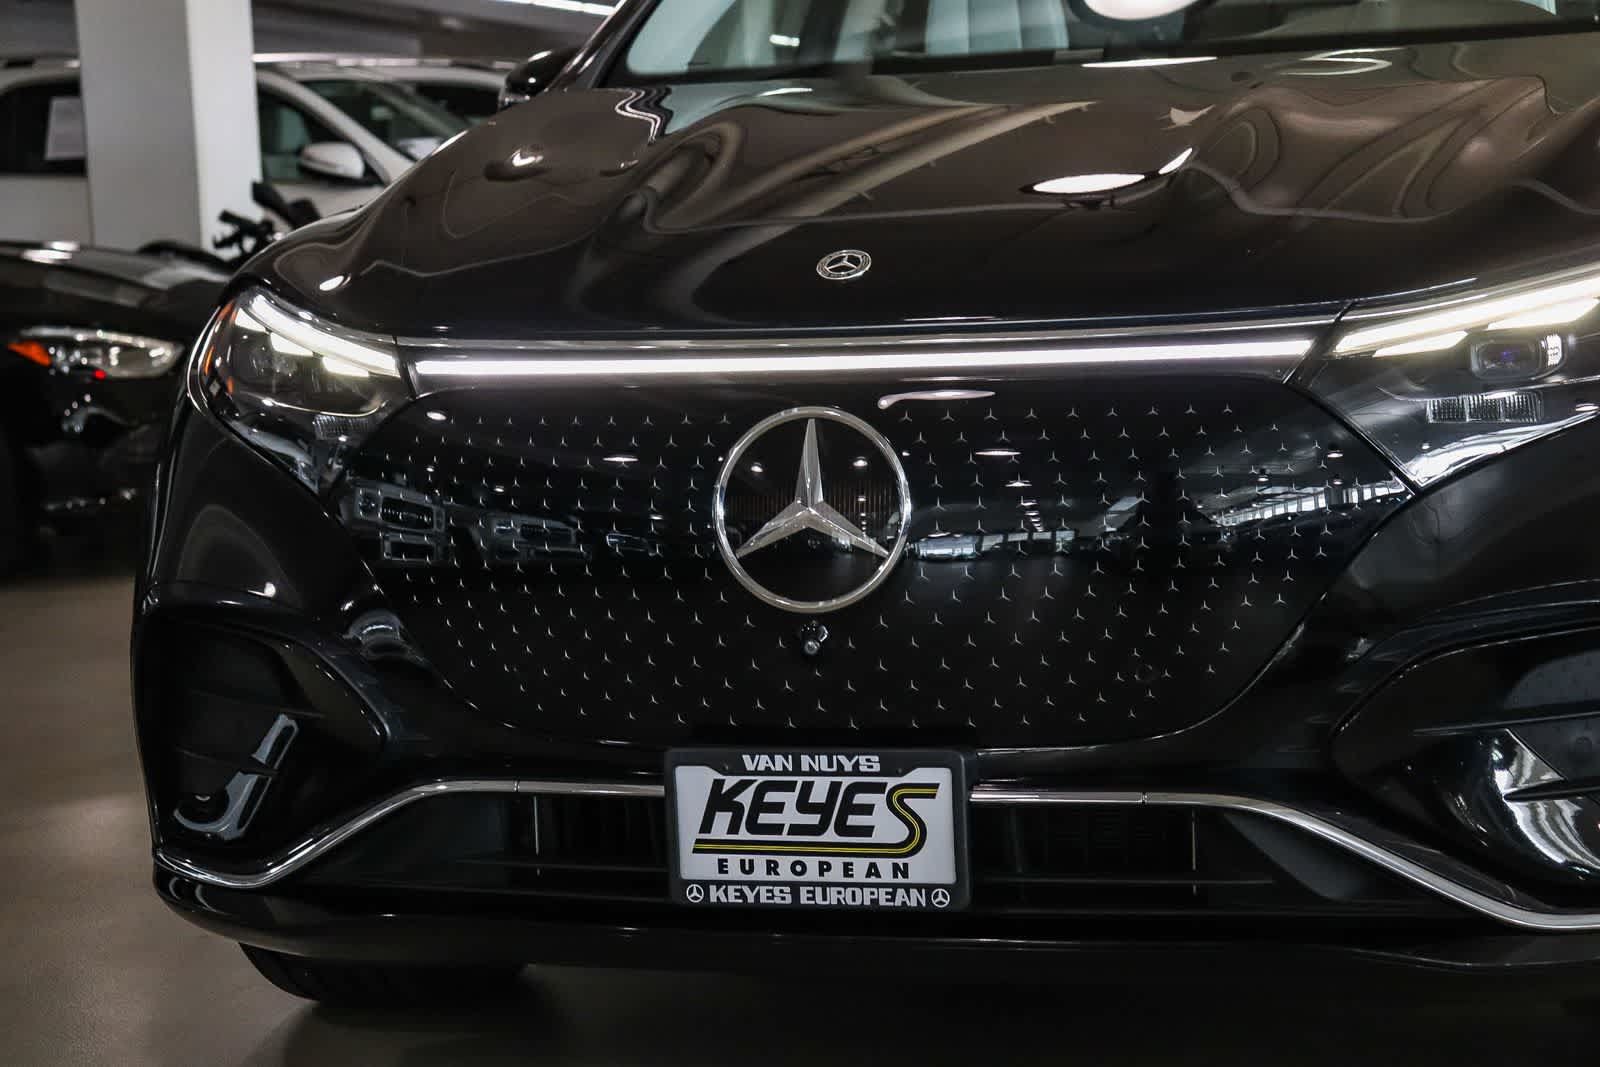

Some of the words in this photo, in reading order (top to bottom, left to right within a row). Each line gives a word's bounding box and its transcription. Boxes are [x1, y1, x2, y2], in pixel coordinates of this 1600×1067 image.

[742, 754, 793, 772] VAN
[800, 755, 881, 773] NUYS
[692, 778, 940, 858] KEYES
[717, 858, 910, 879] EUROPEAN
[709, 885, 792, 905] KEYES
[800, 886, 926, 907] EUROPEAN
